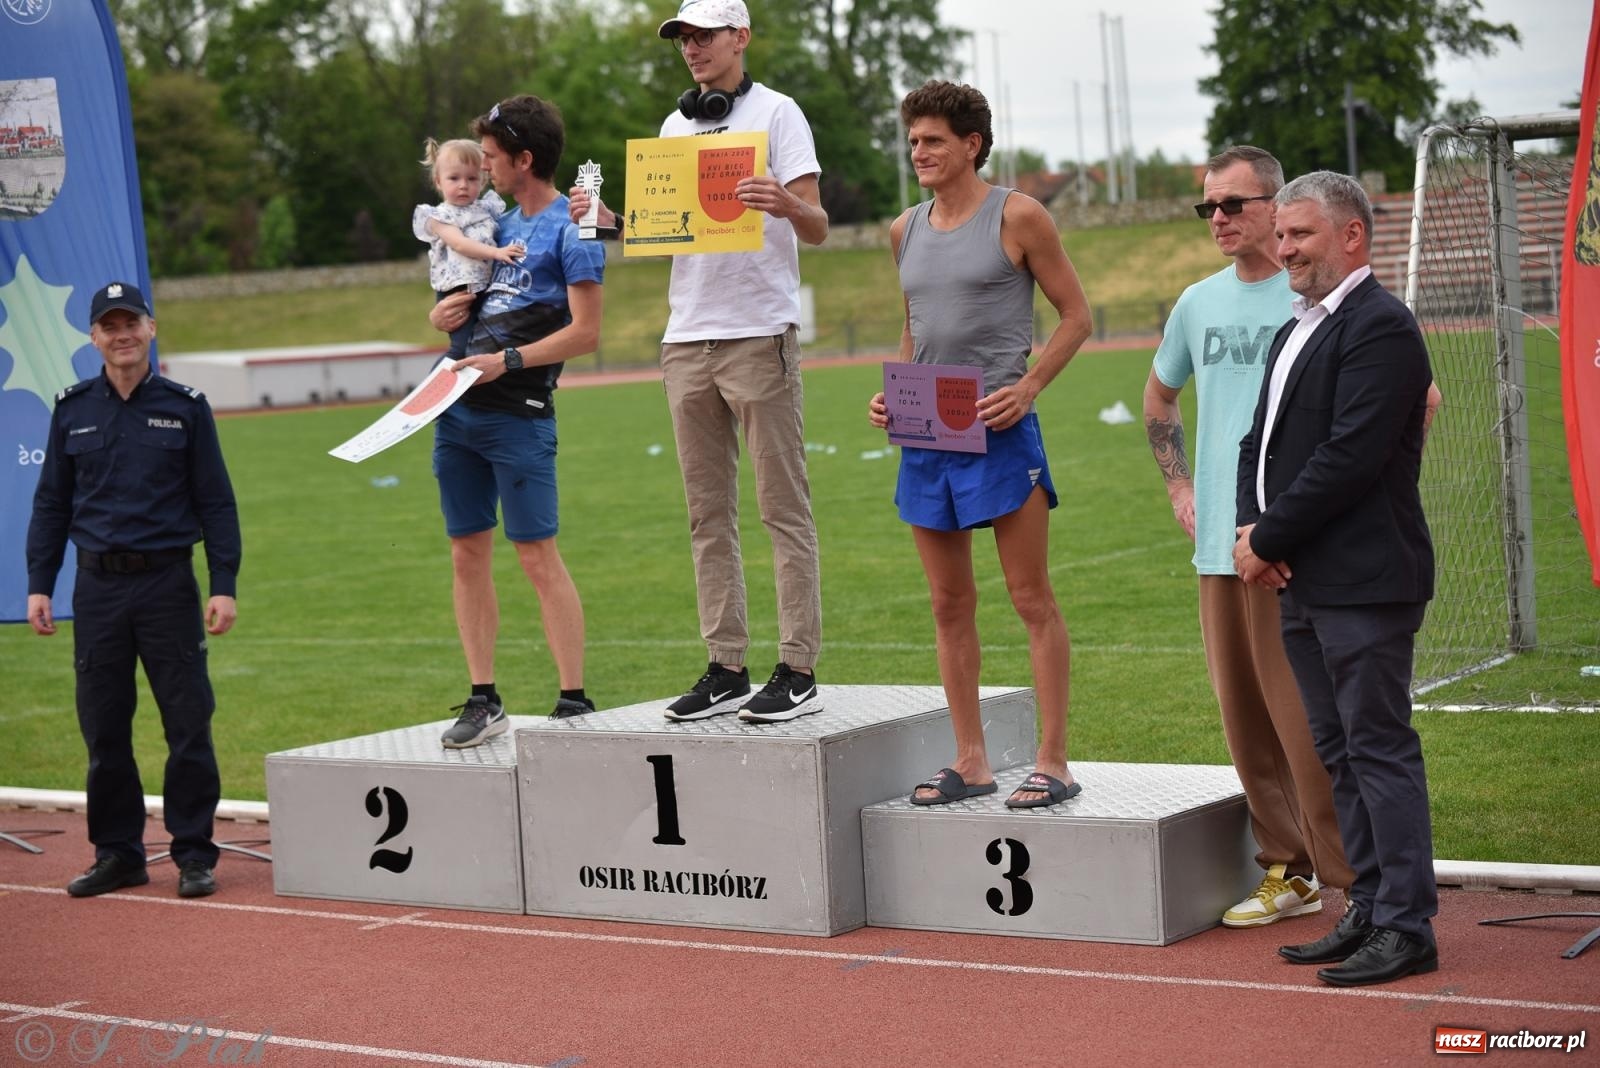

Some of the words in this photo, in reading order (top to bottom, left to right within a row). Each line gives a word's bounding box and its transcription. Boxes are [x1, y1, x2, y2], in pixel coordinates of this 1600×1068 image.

[725, 162, 744, 170] BIEG
[646, 173, 671, 181] Bieg
[701, 171, 716, 179] BEZ
[719, 170, 751, 178] GRANIC
[645, 187, 657, 195] 10
[706, 227, 736, 235] Racibórz
[899, 388, 917, 397] Bieg
[148, 418, 182, 429] POLICJA
[646, 754, 687, 846] 1
[365, 786, 413, 874] 2
[985, 837, 1034, 917] 3
[579, 865, 637, 891] OSIR
[643, 868, 768, 900] RACIBÓRZ
